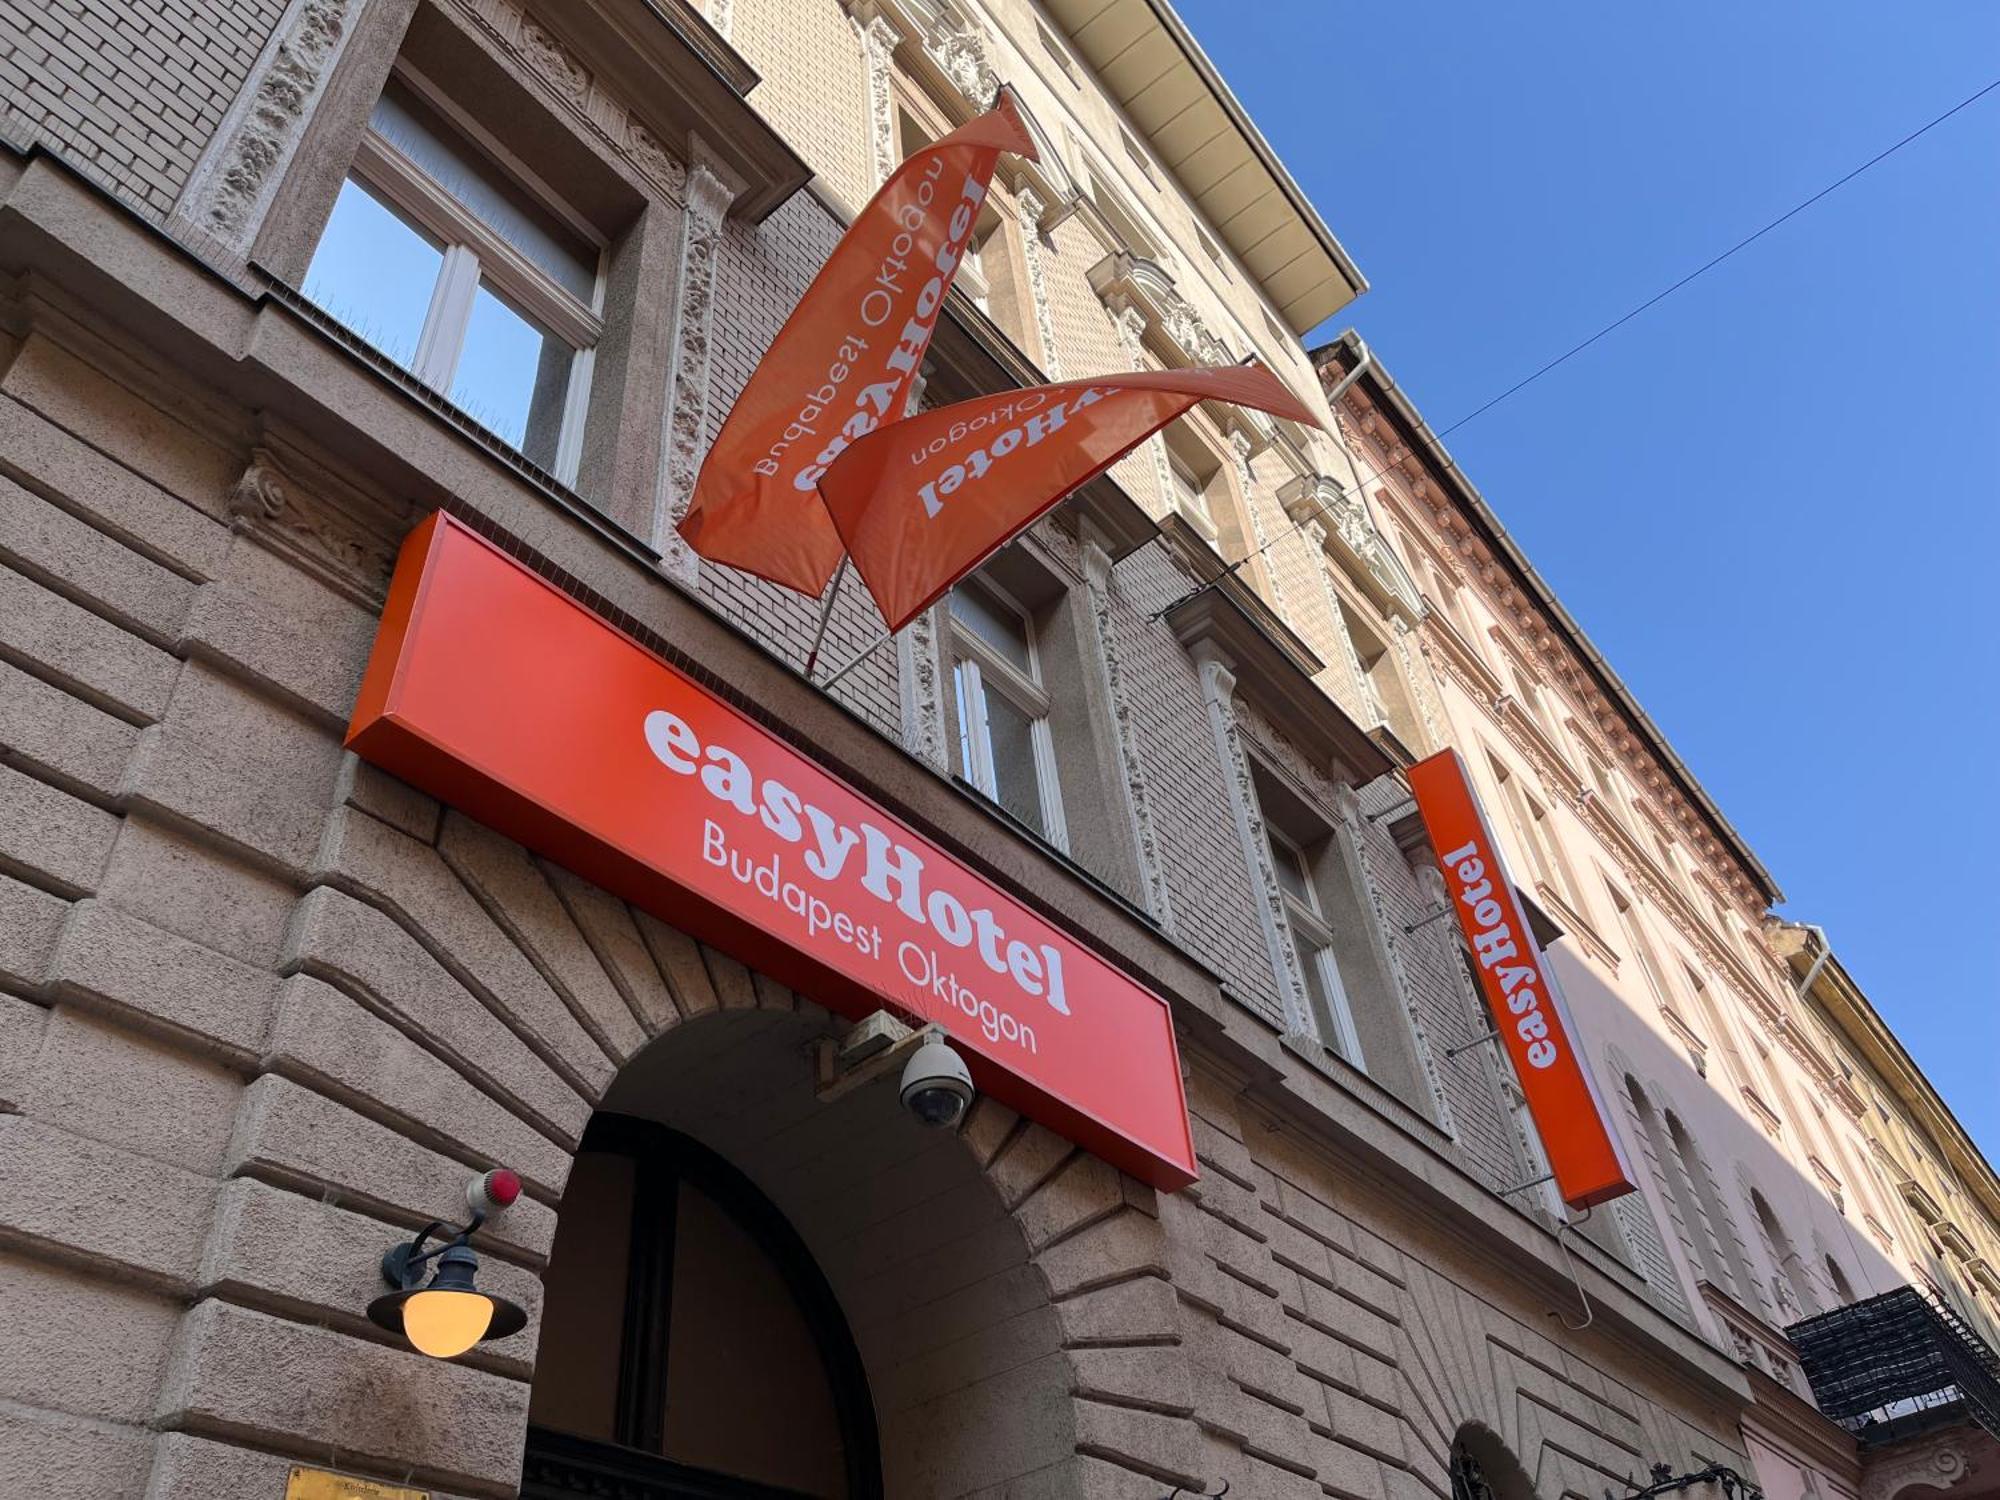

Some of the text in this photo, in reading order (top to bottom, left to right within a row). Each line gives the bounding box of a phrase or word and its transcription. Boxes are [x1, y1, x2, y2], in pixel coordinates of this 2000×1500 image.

[911, 393, 1046, 465] Oktogon
[643, 709, 1072, 1016] easyHotel
[702, 819, 1038, 1055] Budapest Oktogon
[1442, 840, 1558, 1069] easyHotel
